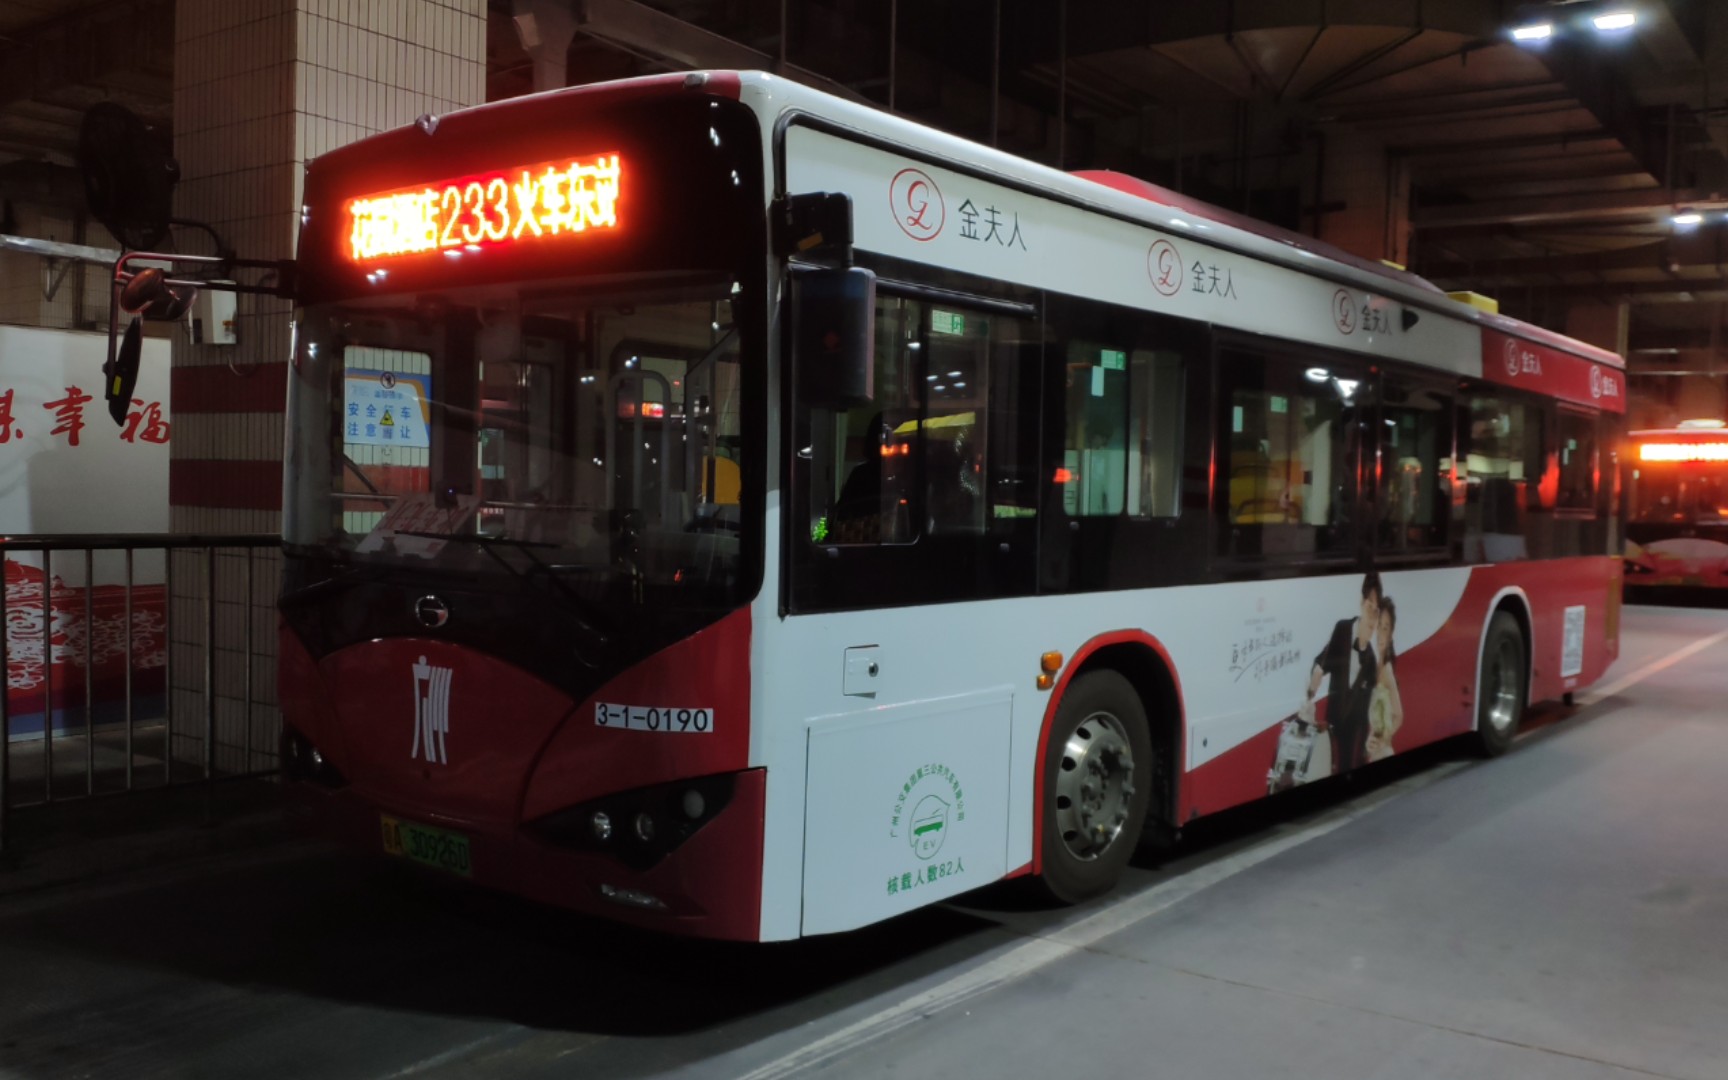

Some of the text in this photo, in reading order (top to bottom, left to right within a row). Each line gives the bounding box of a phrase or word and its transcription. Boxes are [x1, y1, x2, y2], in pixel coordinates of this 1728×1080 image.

[440, 179, 510, 248] 233
[958, 198, 1027, 252] 金夫人
[1190, 260, 1238, 301] 金夫人
[1361, 304, 1393, 337] 金夫人
[347, 422, 412, 440] 注意让
[597, 703, 708, 732] 3-1-0190
